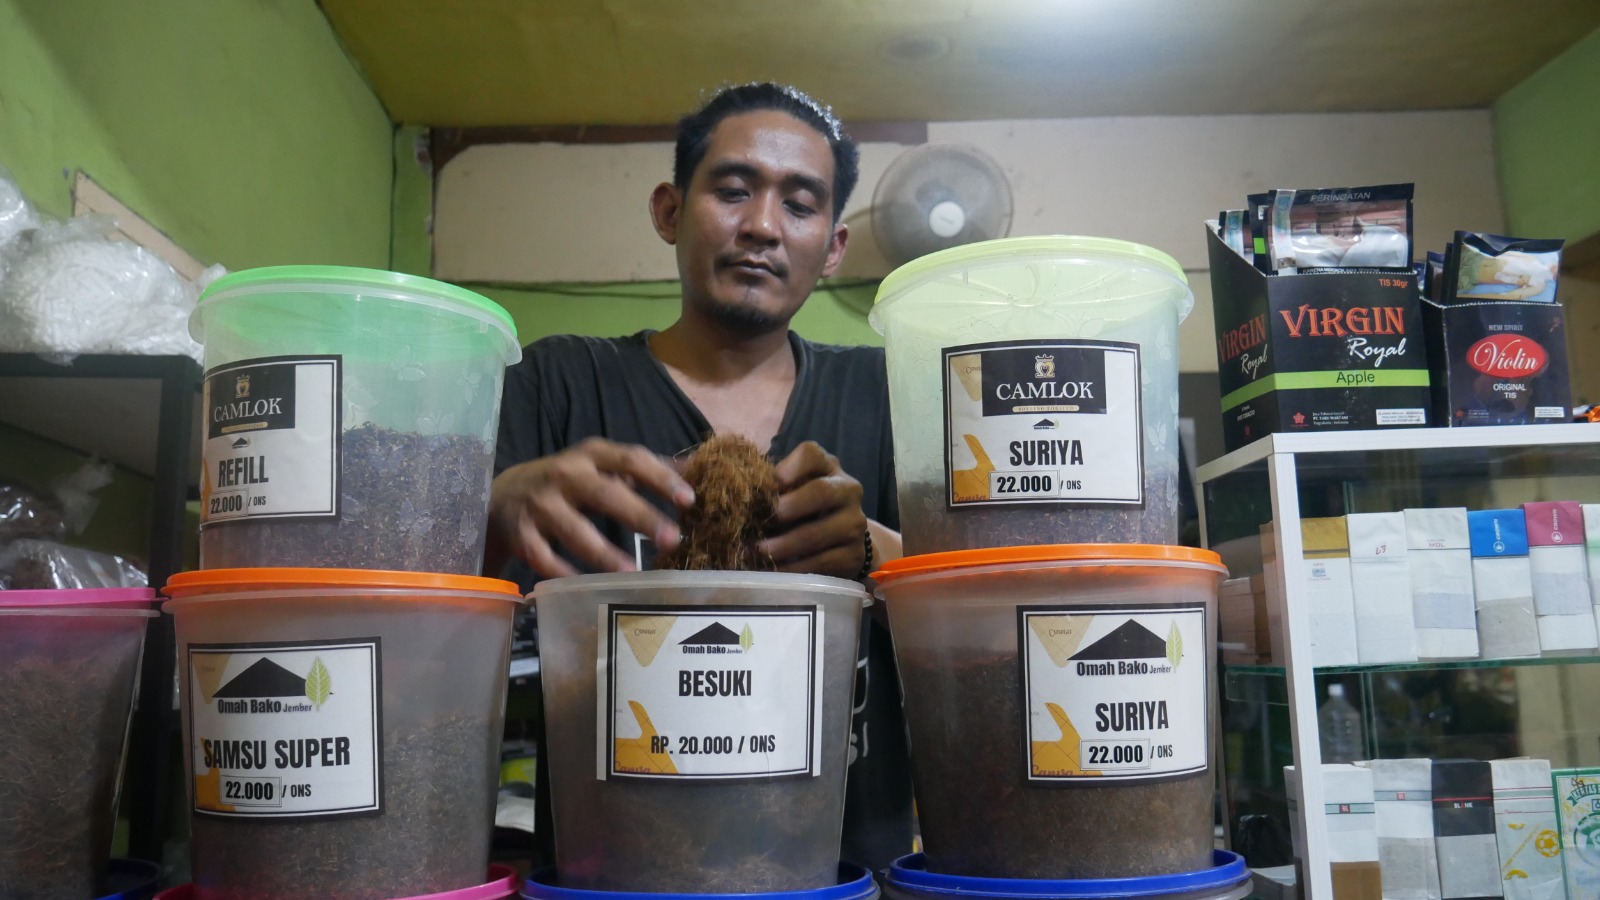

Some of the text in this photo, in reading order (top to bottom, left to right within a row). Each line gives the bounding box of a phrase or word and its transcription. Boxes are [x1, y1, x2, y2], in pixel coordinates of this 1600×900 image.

[1310, 192, 1371, 201] PERINGATAN
[1392, 279, 1408, 288] 30gr
[1279, 304, 1405, 337] VIRGIN
[1218, 313, 1267, 364] VIRGIN
[1241, 344, 1268, 380] Royal
[1348, 337, 1407, 368] Royal
[1473, 340, 1538, 372] Violin
[1336, 371, 1375, 385] Apple
[996, 382, 1094, 400] CAMLOK
[214, 398, 282, 422] CAMLOK
[1009, 440, 1084, 466] SURIYA
[218, 456, 269, 487] REFILL
[997, 476, 1052, 493] 22.000
[1066, 480, 1081, 490] ONS
[211, 494, 242, 514] 22.000
[254, 496, 266, 506] ONS
[683, 645, 705, 654] Omah
[707, 645, 726, 654] Bako
[1077, 661, 1171, 676] Omah Bako Jember
[678, 670, 752, 697] BESUKI
[218, 699, 312, 714] Omah Bako Jember
[1095, 700, 1169, 732] SURIYA
[204, 736, 350, 770] SAMSU SUPER
[651, 734, 776, 754] RP. 20.000 / ONS
[1089, 745, 1173, 764] 22.000 / ONS
[225, 781, 312, 800] 22.000 / ONS
